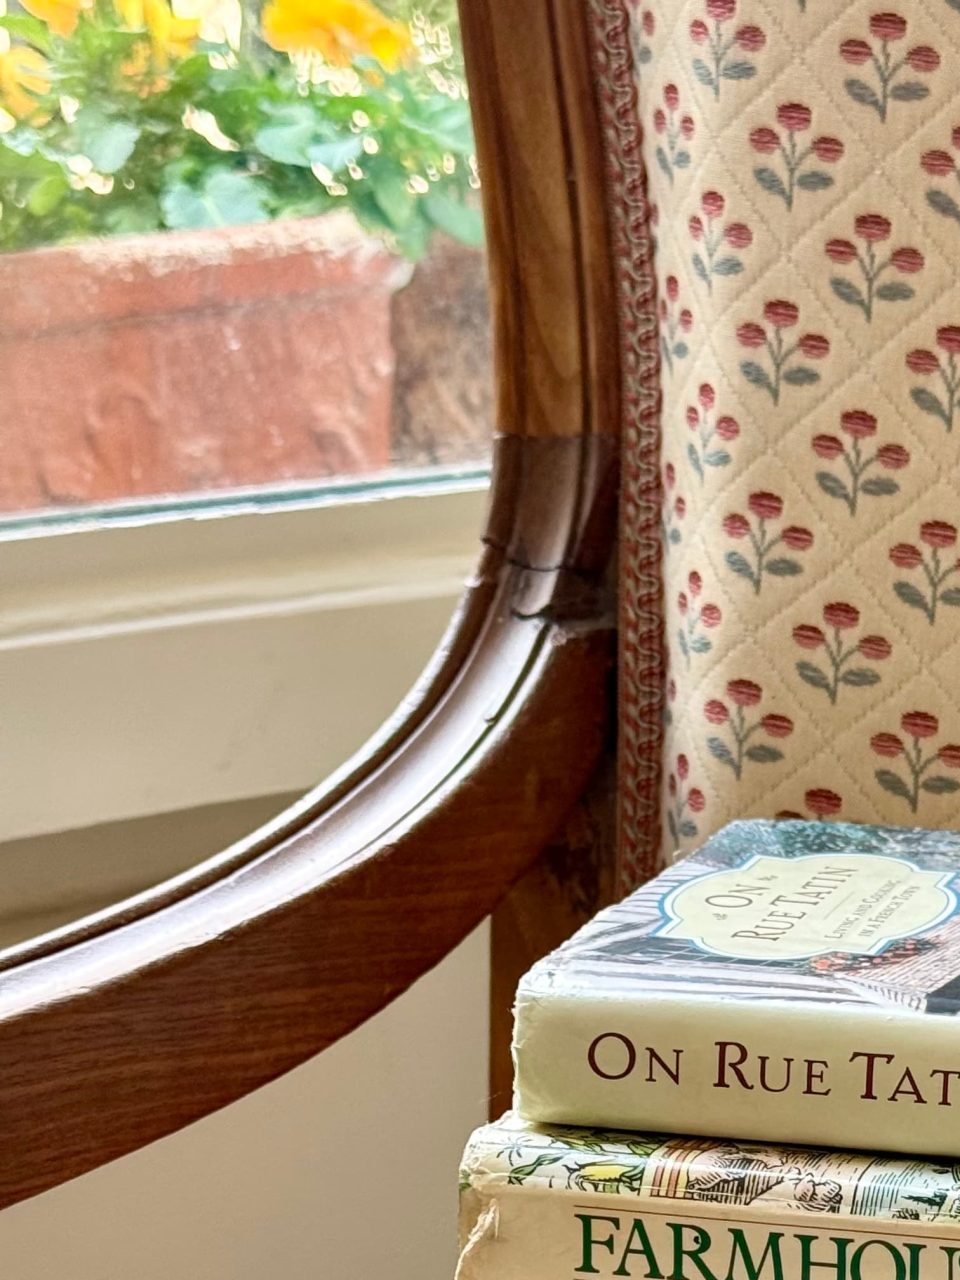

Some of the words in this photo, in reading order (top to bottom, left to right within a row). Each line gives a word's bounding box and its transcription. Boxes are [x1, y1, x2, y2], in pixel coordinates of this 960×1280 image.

[705, 884, 770, 908] ON
[731, 911, 807, 942] RUE
[770, 866, 859, 906] TATIN
[587, 1032, 684, 1086] ON
[713, 1041, 833, 1097] RUE
